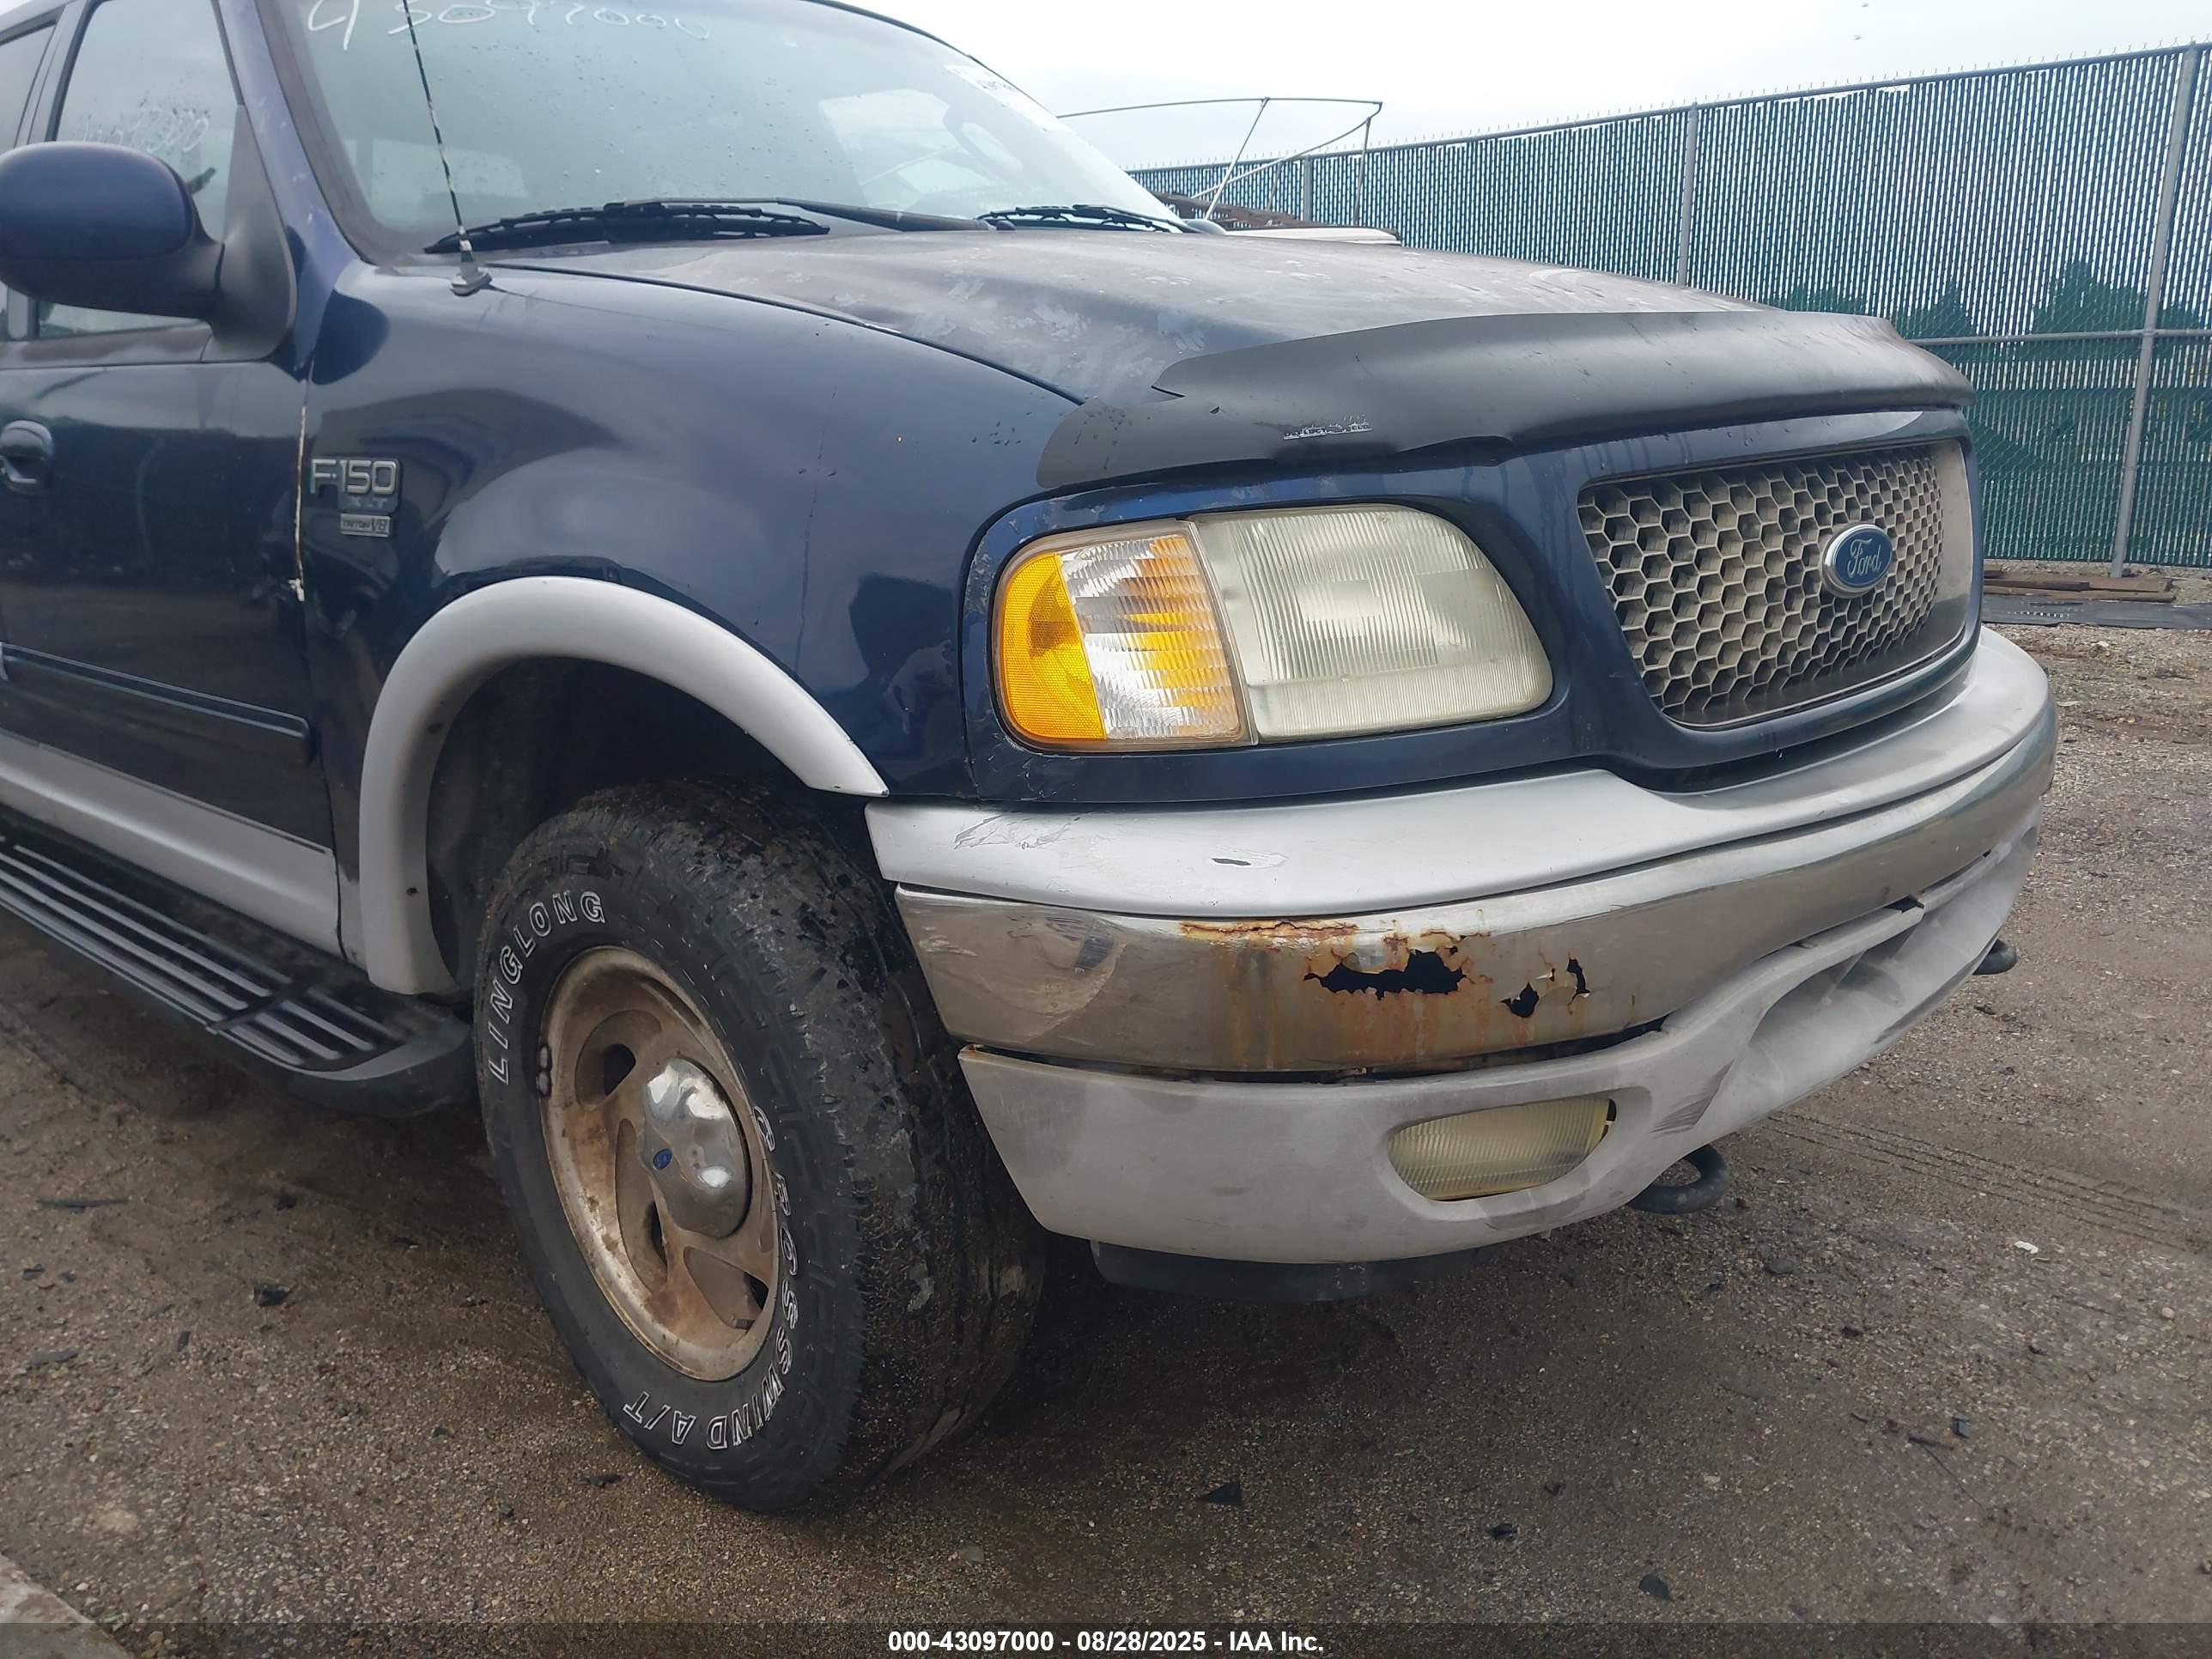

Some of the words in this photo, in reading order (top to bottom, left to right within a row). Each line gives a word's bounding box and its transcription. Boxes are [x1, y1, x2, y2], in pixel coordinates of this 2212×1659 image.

[371, 517, 386, 532] V8
[1847, 538, 1883, 579] Ford
[488, 890, 606, 1086] LINGLONG
[623, 1390, 698, 1445] A/T
